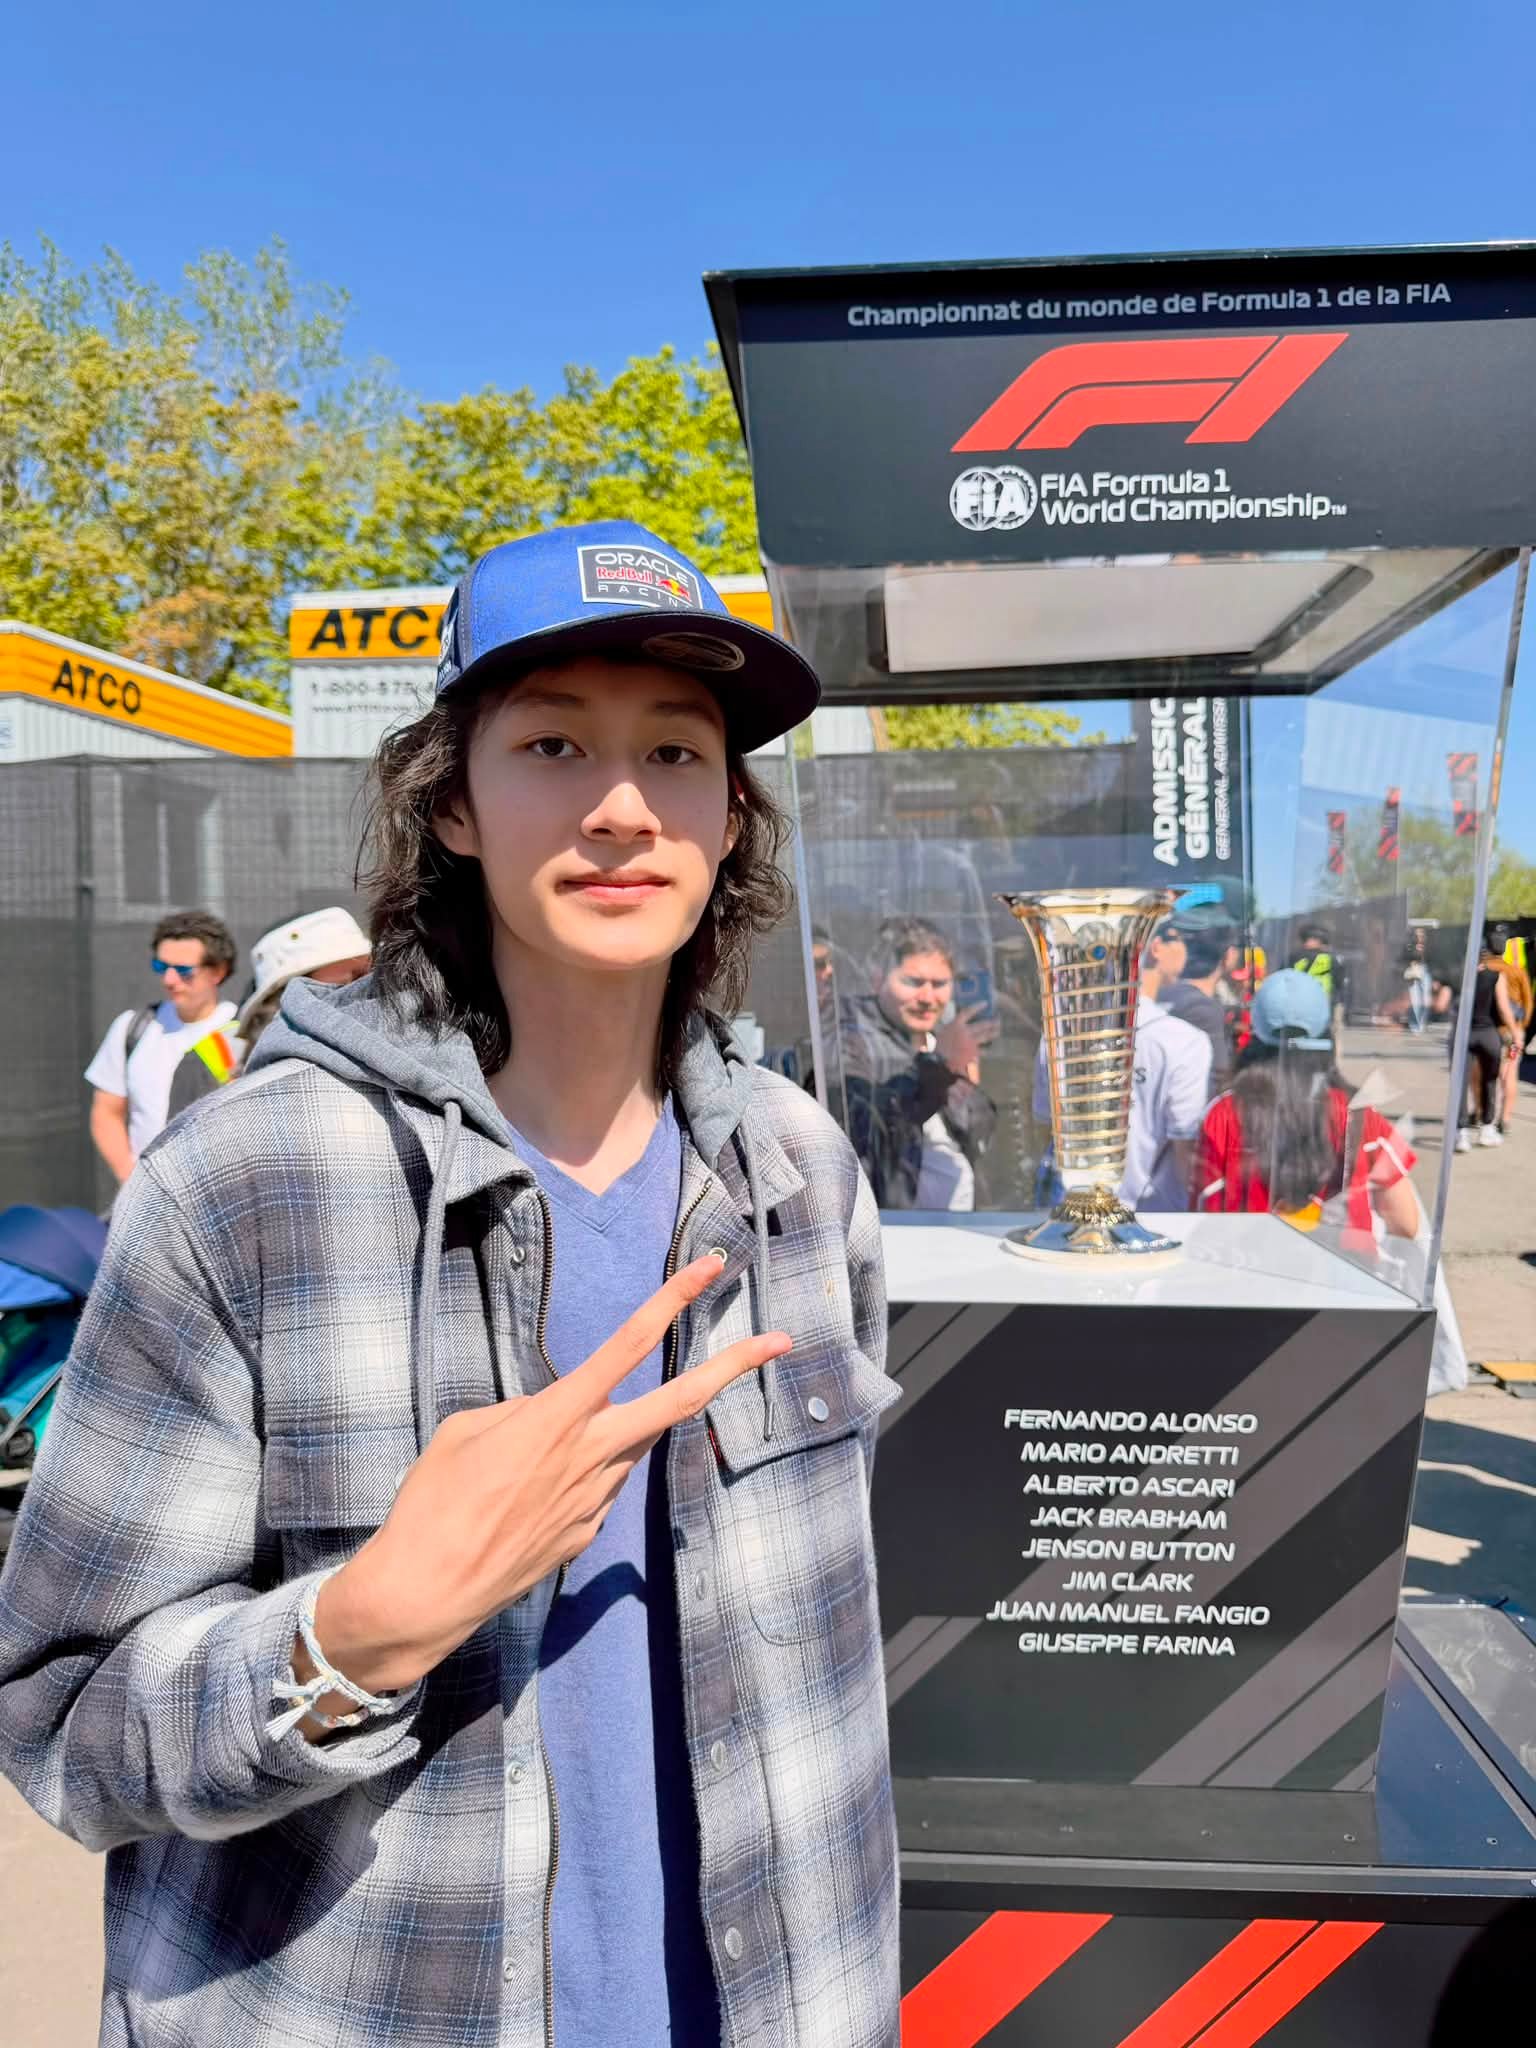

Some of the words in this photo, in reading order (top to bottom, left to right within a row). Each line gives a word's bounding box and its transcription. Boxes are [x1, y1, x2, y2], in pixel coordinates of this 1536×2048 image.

[847, 301, 1022, 327] Championnat
[1027, 299, 1061, 319] du
[1066, 295, 1159, 318] monde
[1163, 293, 1197, 315] de
[1201, 289, 1311, 313] Formula
[1316, 288, 1332, 308] 1
[1337, 286, 1371, 307] de
[1377, 285, 1400, 306] la
[1406, 282, 1452, 305] FIA
[1040, 472, 1089, 499] FIA
[1092, 469, 1211, 497] Formula
[1213, 468, 1232, 492] 1
[1040, 498, 1127, 526] World
[594, 551, 689, 588] ORACLE
[596, 566, 625, 580] Red
[625, 567, 653, 585] Bull
[306, 605, 445, 652] ATC
[51, 659, 142, 715] ATCO
[1003, 1409, 1147, 1433] FERNANDO
[1150, 1412, 1258, 1434] ALONSO
[1020, 1441, 1107, 1463] MARIO
[1108, 1444, 1240, 1466] ANDRETTI
[1022, 1474, 1139, 1497] ALBERTO
[1141, 1477, 1236, 1498] ASCARI
[1030, 1506, 1095, 1528] JACK
[1098, 1508, 1227, 1530] BRABHAM
[1021, 1538, 1126, 1560] JENSON
[1129, 1541, 1236, 1562] BUTTON
[1062, 1571, 1107, 1592] JIM
[1111, 1573, 1194, 1593] CLARK
[986, 1600, 1056, 1622] JUAN
[1059, 1602, 1170, 1624] MANUEL
[1174, 1605, 1271, 1626] FANGIO
[1018, 1632, 1139, 1655] GIUSEPPE
[1142, 1634, 1236, 1657] FARINA
